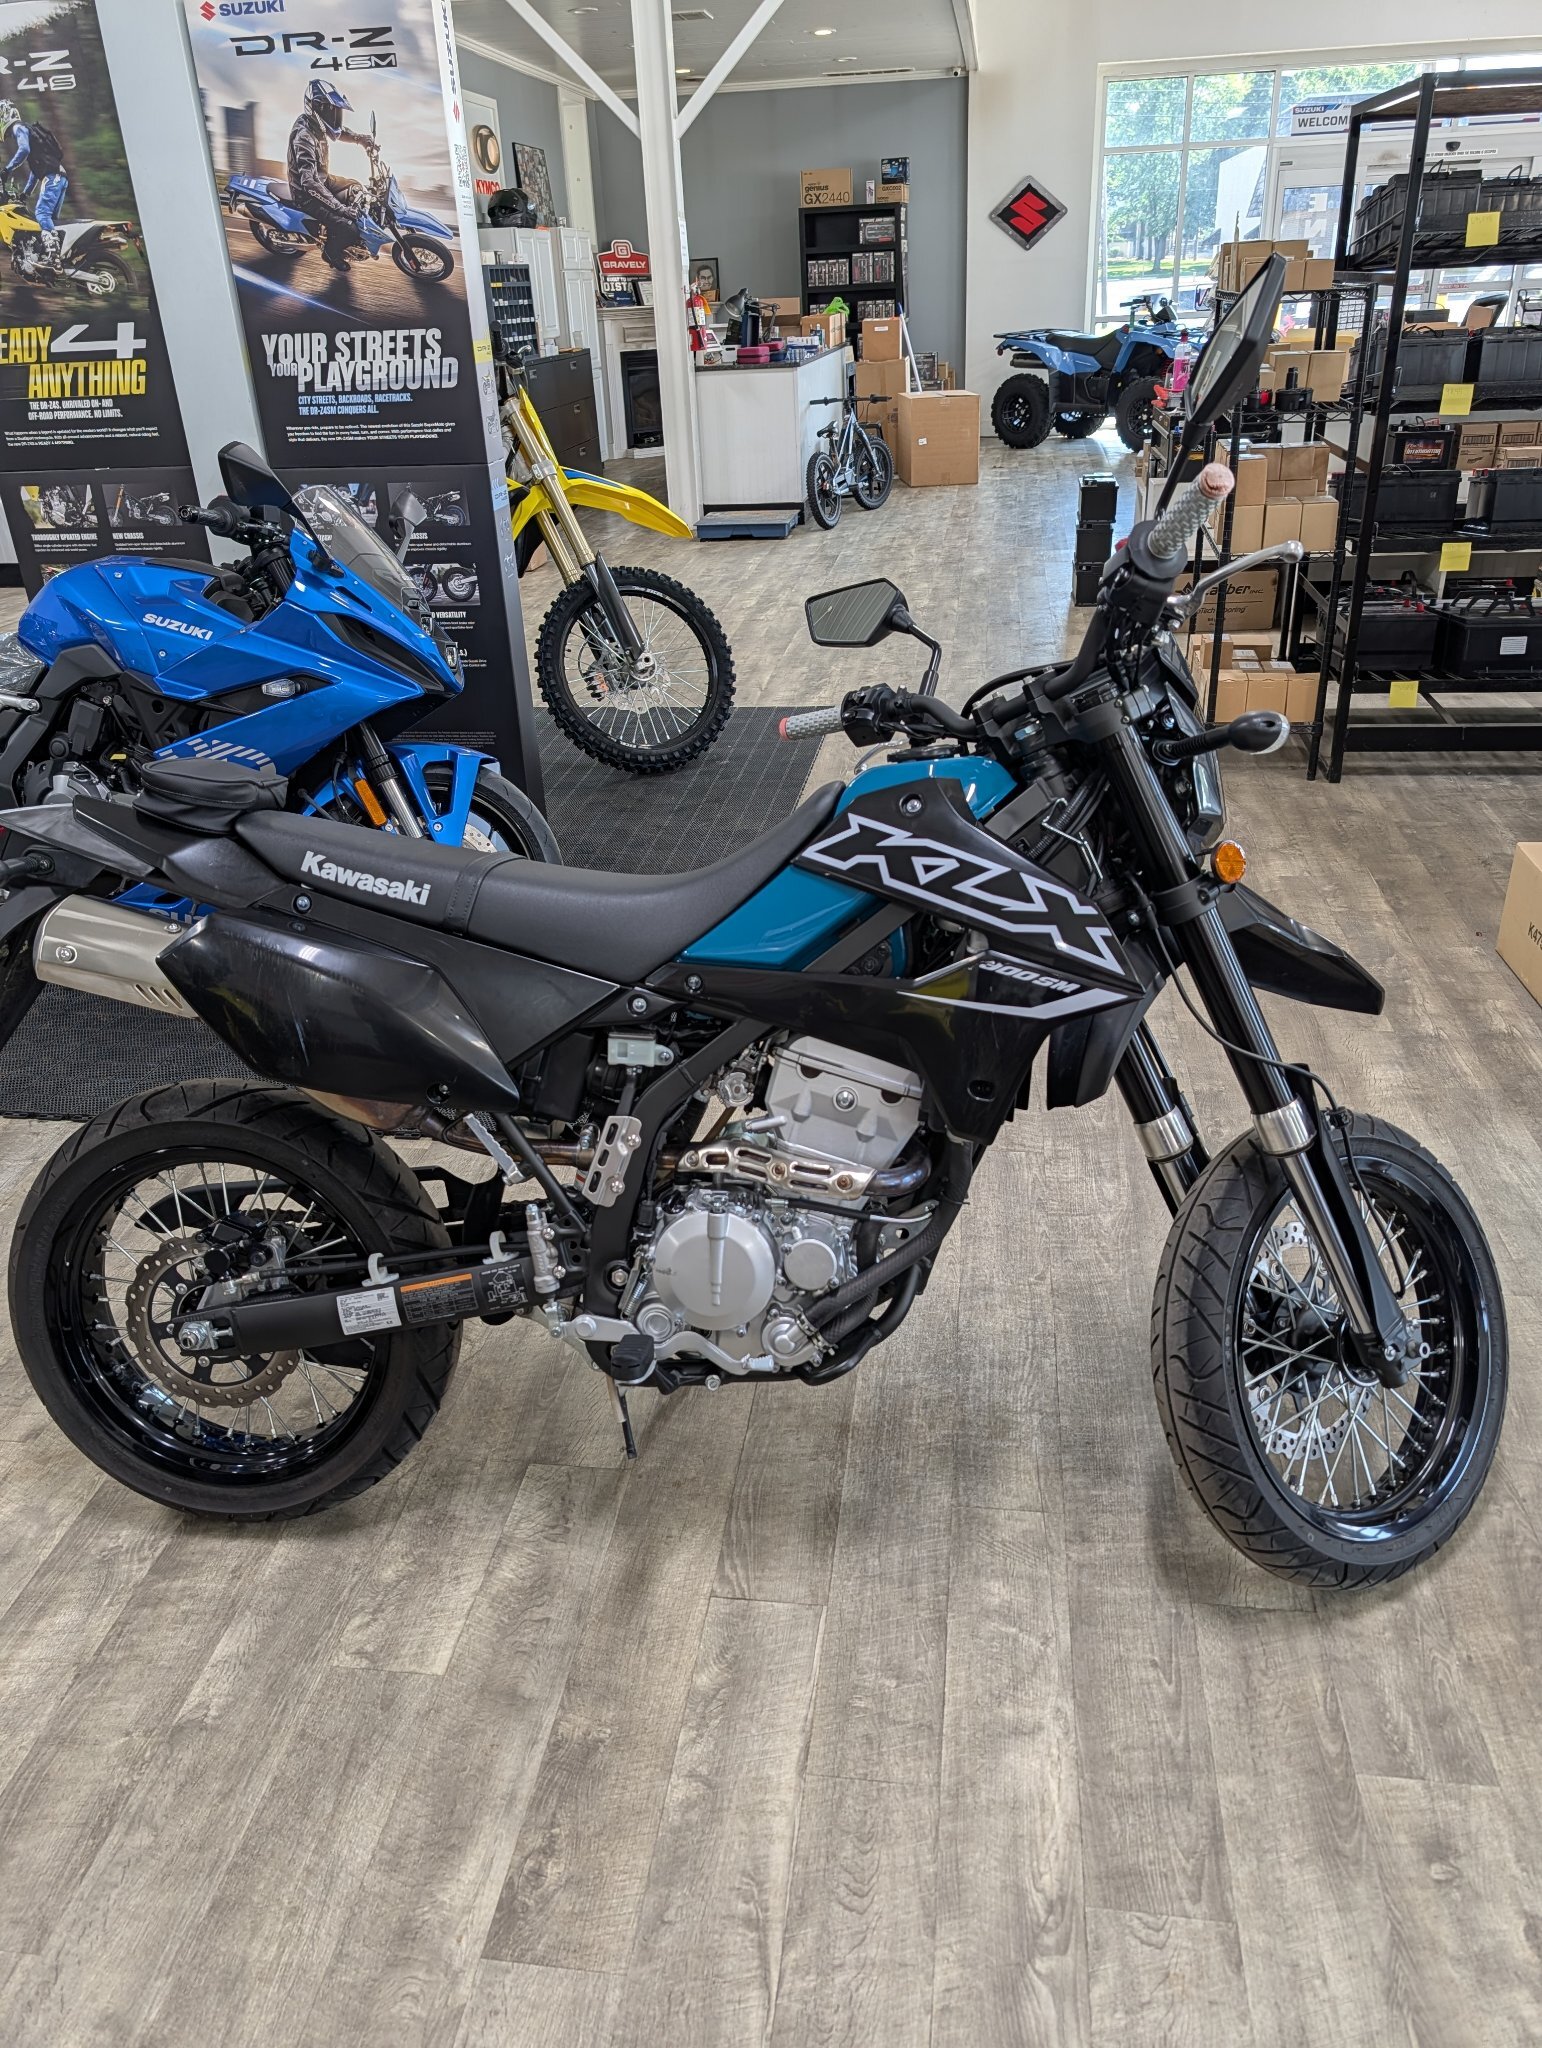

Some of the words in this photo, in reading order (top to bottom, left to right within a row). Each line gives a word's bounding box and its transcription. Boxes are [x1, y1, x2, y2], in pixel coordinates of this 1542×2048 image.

[219, 0, 285, 17] SUZUKI
[230, 26, 395, 56] DR-Z
[441, 0, 457, 95] SUZUK
[0, 50, 72, 74] -Z
[310, 53, 397, 71] 4SM
[1294, 106, 1325, 114] SUZUKI
[1298, 115, 1348, 127] WELCOM
[804, 191, 850, 204] GX2440
[805, 184, 829, 193] genius
[602, 261, 646, 269] GRAVELY
[0, 326, 51, 364] EADY
[51, 322, 147, 359] 4
[261, 333, 327, 365] YOUR
[334, 328, 442, 361] STREETS
[28, 359, 147, 399] ANYTHING
[270, 363, 298, 377] YOUR
[297, 357, 459, 393] PLAYGROUND
[298, 396, 311, 404] CITY
[312, 395, 338, 405] STREETS,
[338, 394, 374, 404] BACKROADS,
[374, 393, 413, 402] RACETRACKS.
[299, 407, 309, 415] THE
[337, 405, 367, 415] CONQUERS
[367, 405, 379, 414] ALL.
[142, 613, 213, 640] SUZUKI
[301, 851, 431, 905] Kawasaki
